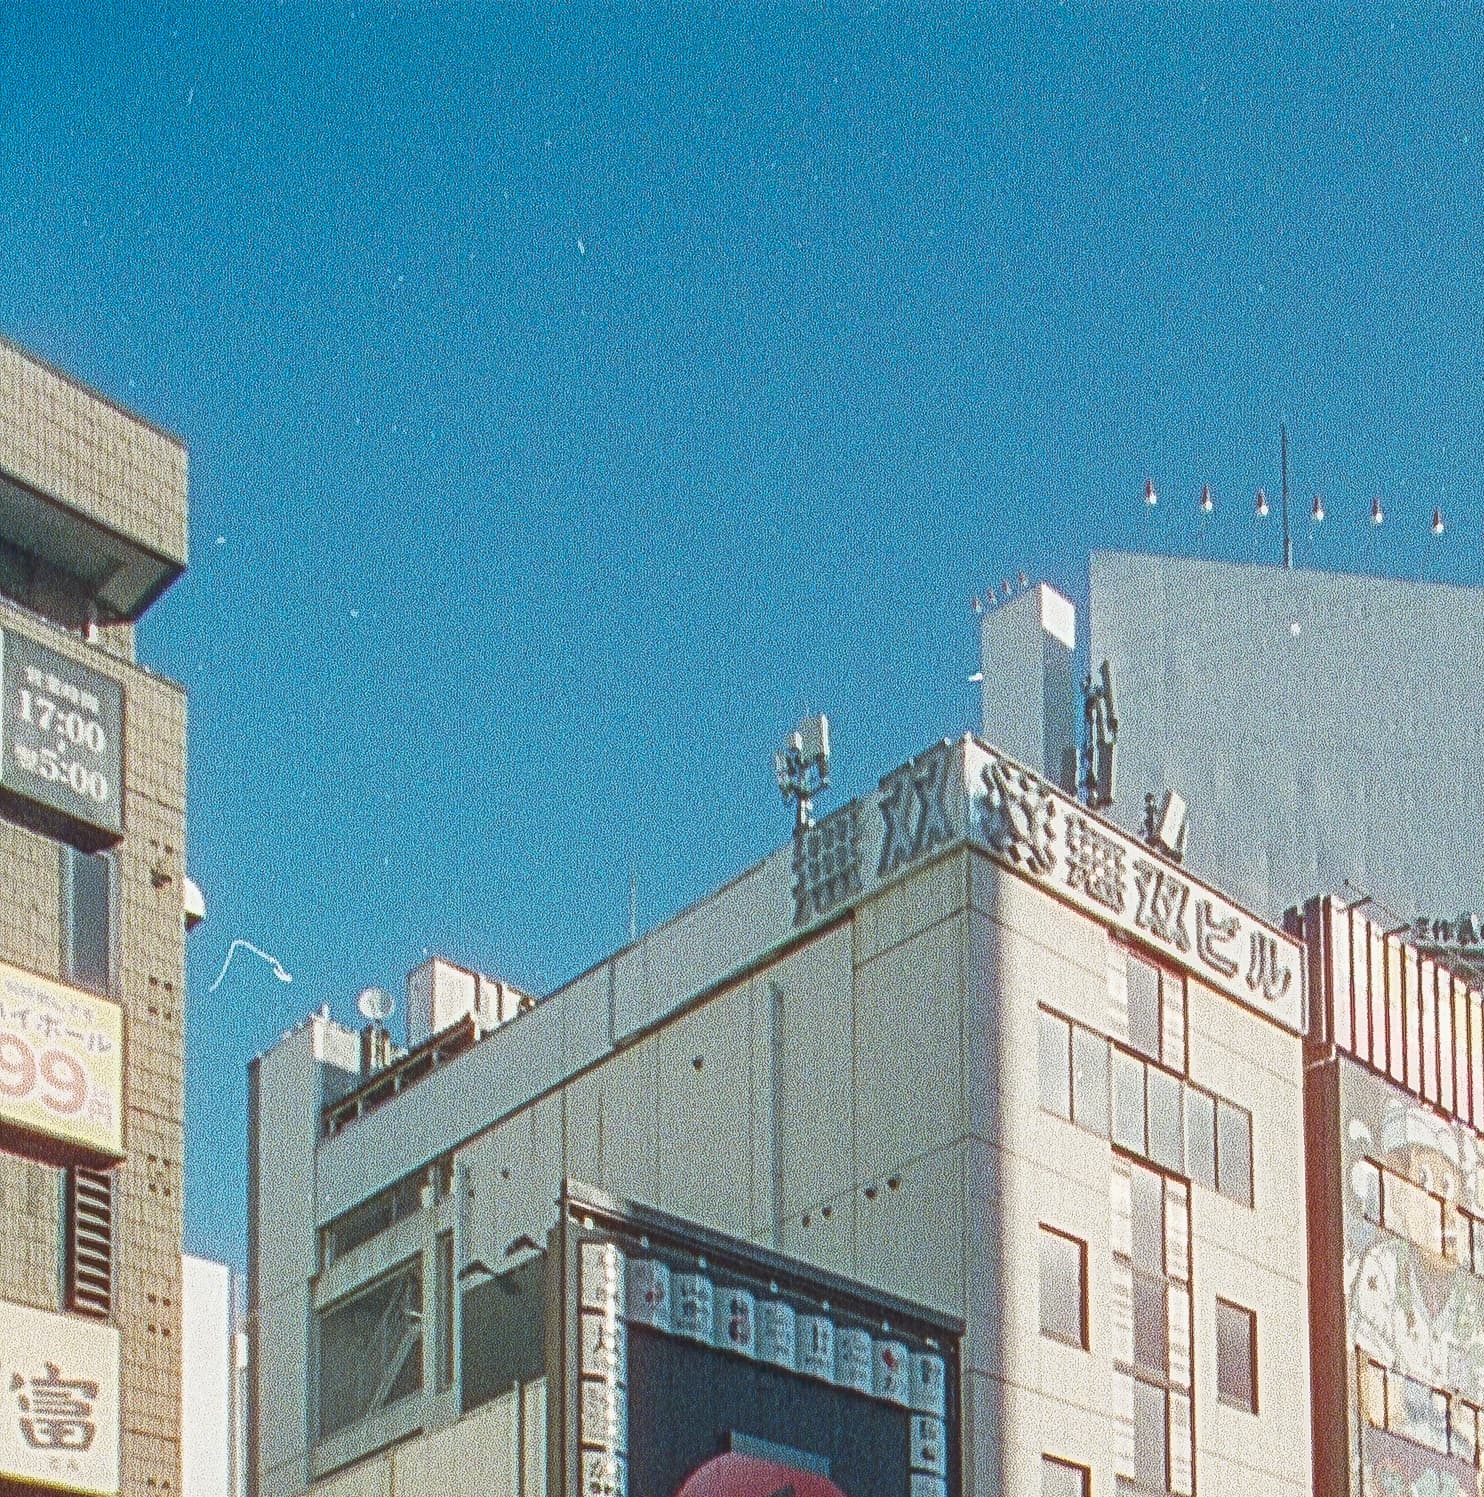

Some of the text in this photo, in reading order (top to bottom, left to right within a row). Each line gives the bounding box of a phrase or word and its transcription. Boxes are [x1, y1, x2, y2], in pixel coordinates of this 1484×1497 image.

[19, 689, 106, 753] 17:00
[0, 1007, 112, 1056] イボール
[9, 1360, 100, 1453] 富
